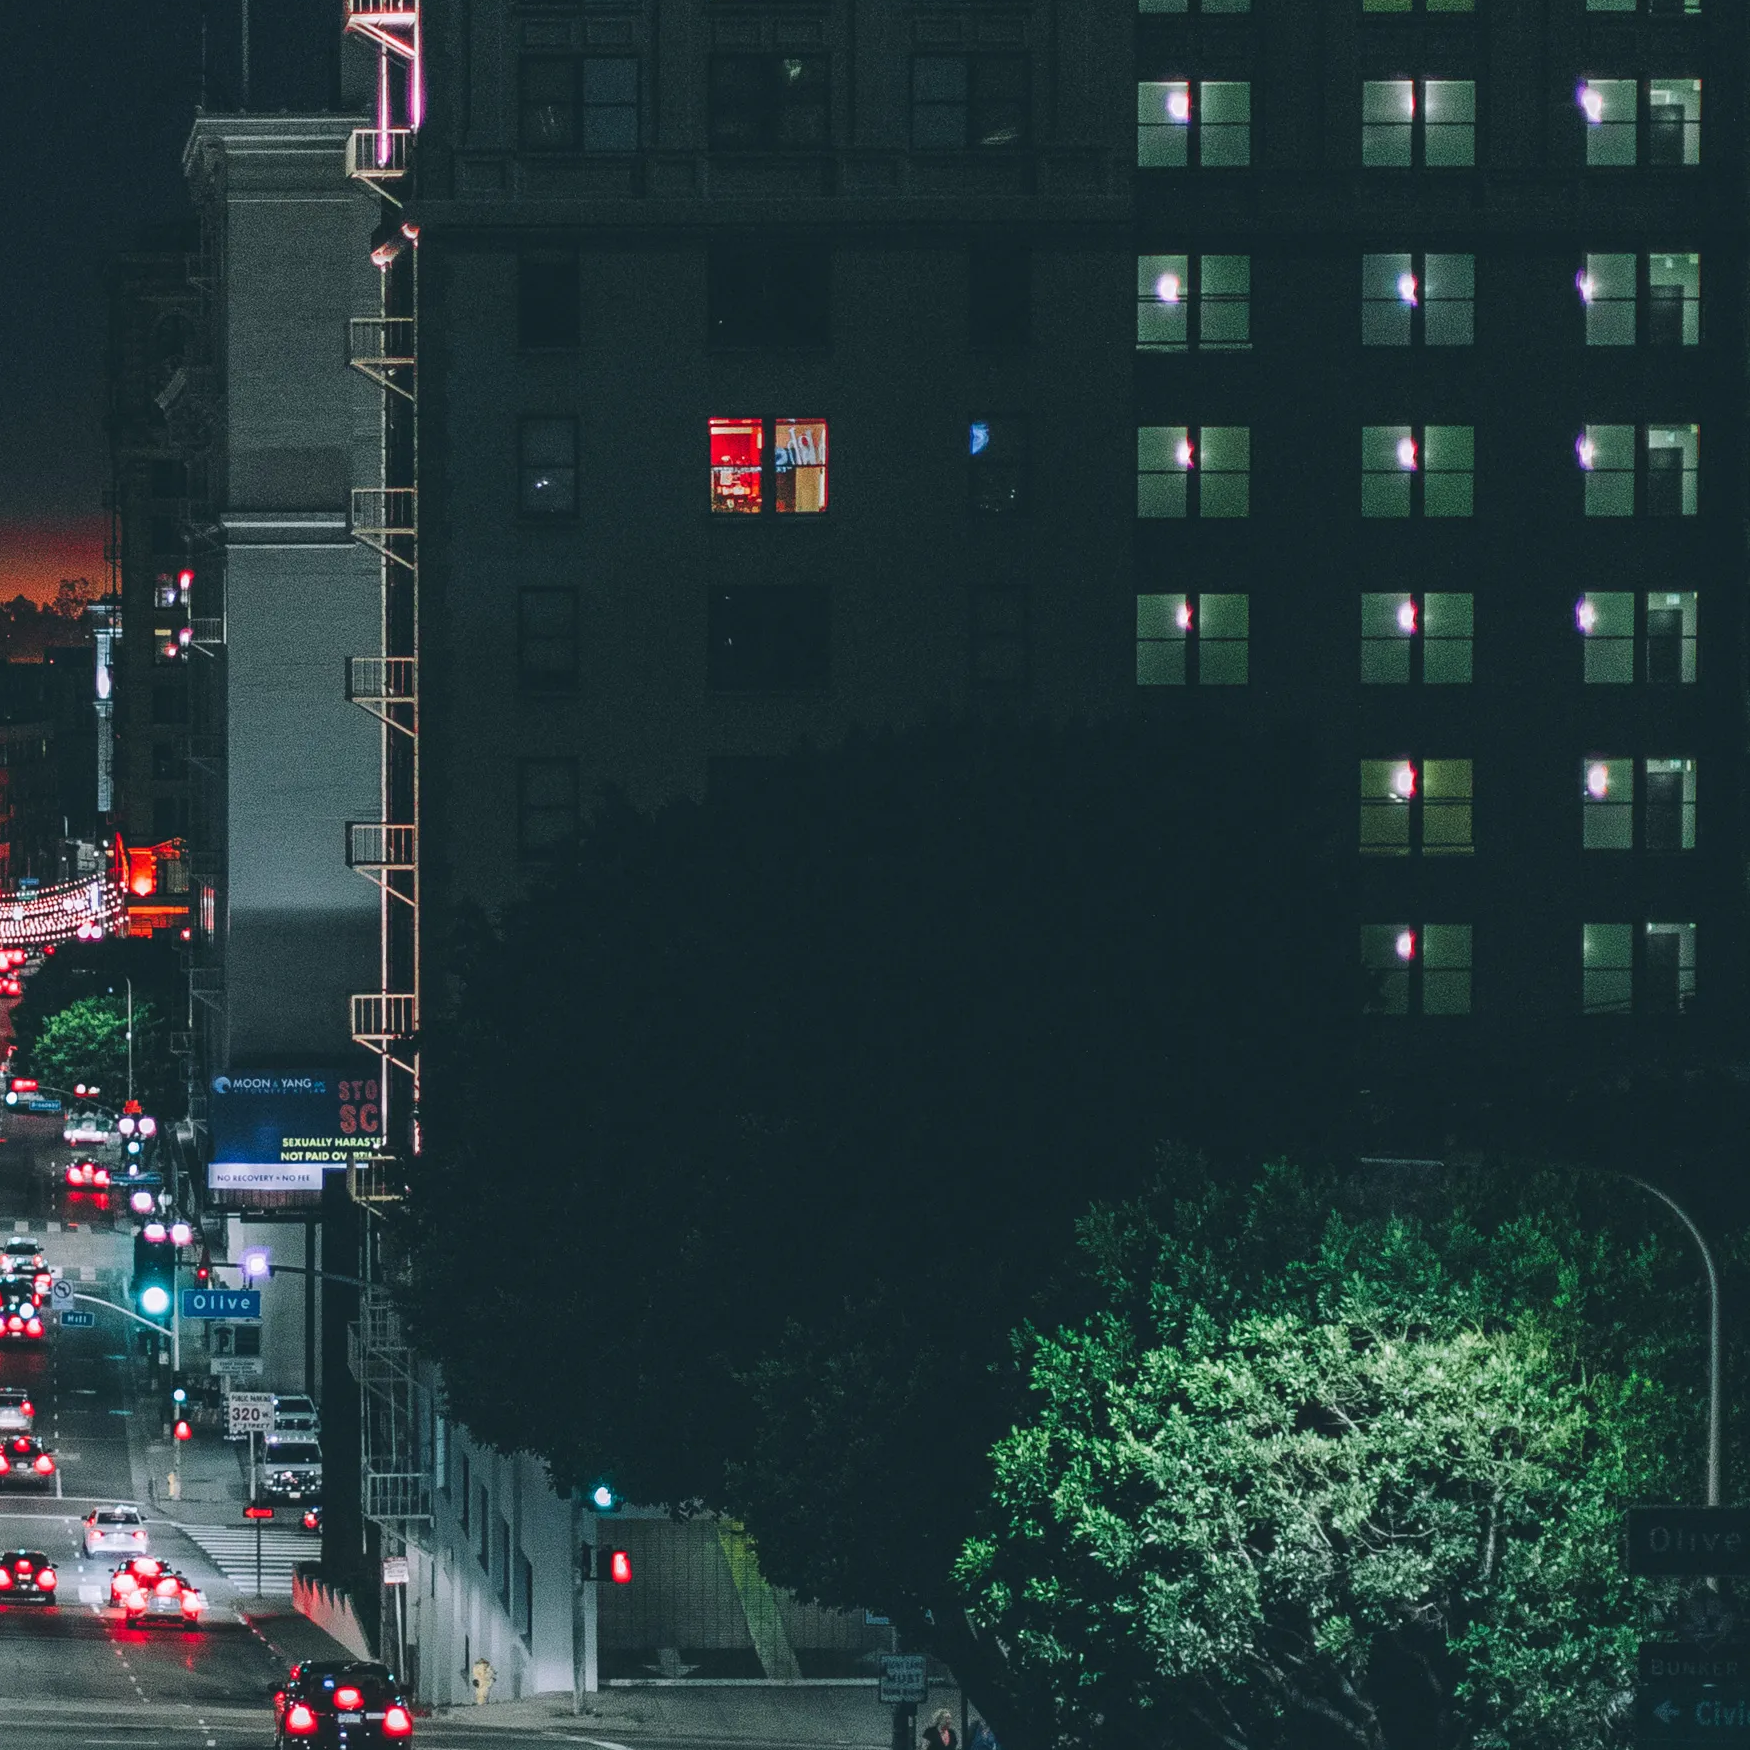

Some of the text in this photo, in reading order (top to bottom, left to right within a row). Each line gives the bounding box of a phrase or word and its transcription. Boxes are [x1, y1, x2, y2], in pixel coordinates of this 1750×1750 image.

[233, 1079, 271, 1088] MOON
[281, 1079, 312, 1088] YANG
[282, 1138, 332, 1147] SEXUALLY
[281, 1151, 303, 1161] NOT
[305, 1151, 330, 1161] PAID
[193, 1295, 251, 1310] Olive
[67, 1315, 87, 1323] Hill
[232, 1407, 260, 1421] 320
[1648, 1525, 1742, 1553] Olive
[1650, 1658, 1739, 1676] BUNKER
[1694, 1700, 1750, 1727] Civi
